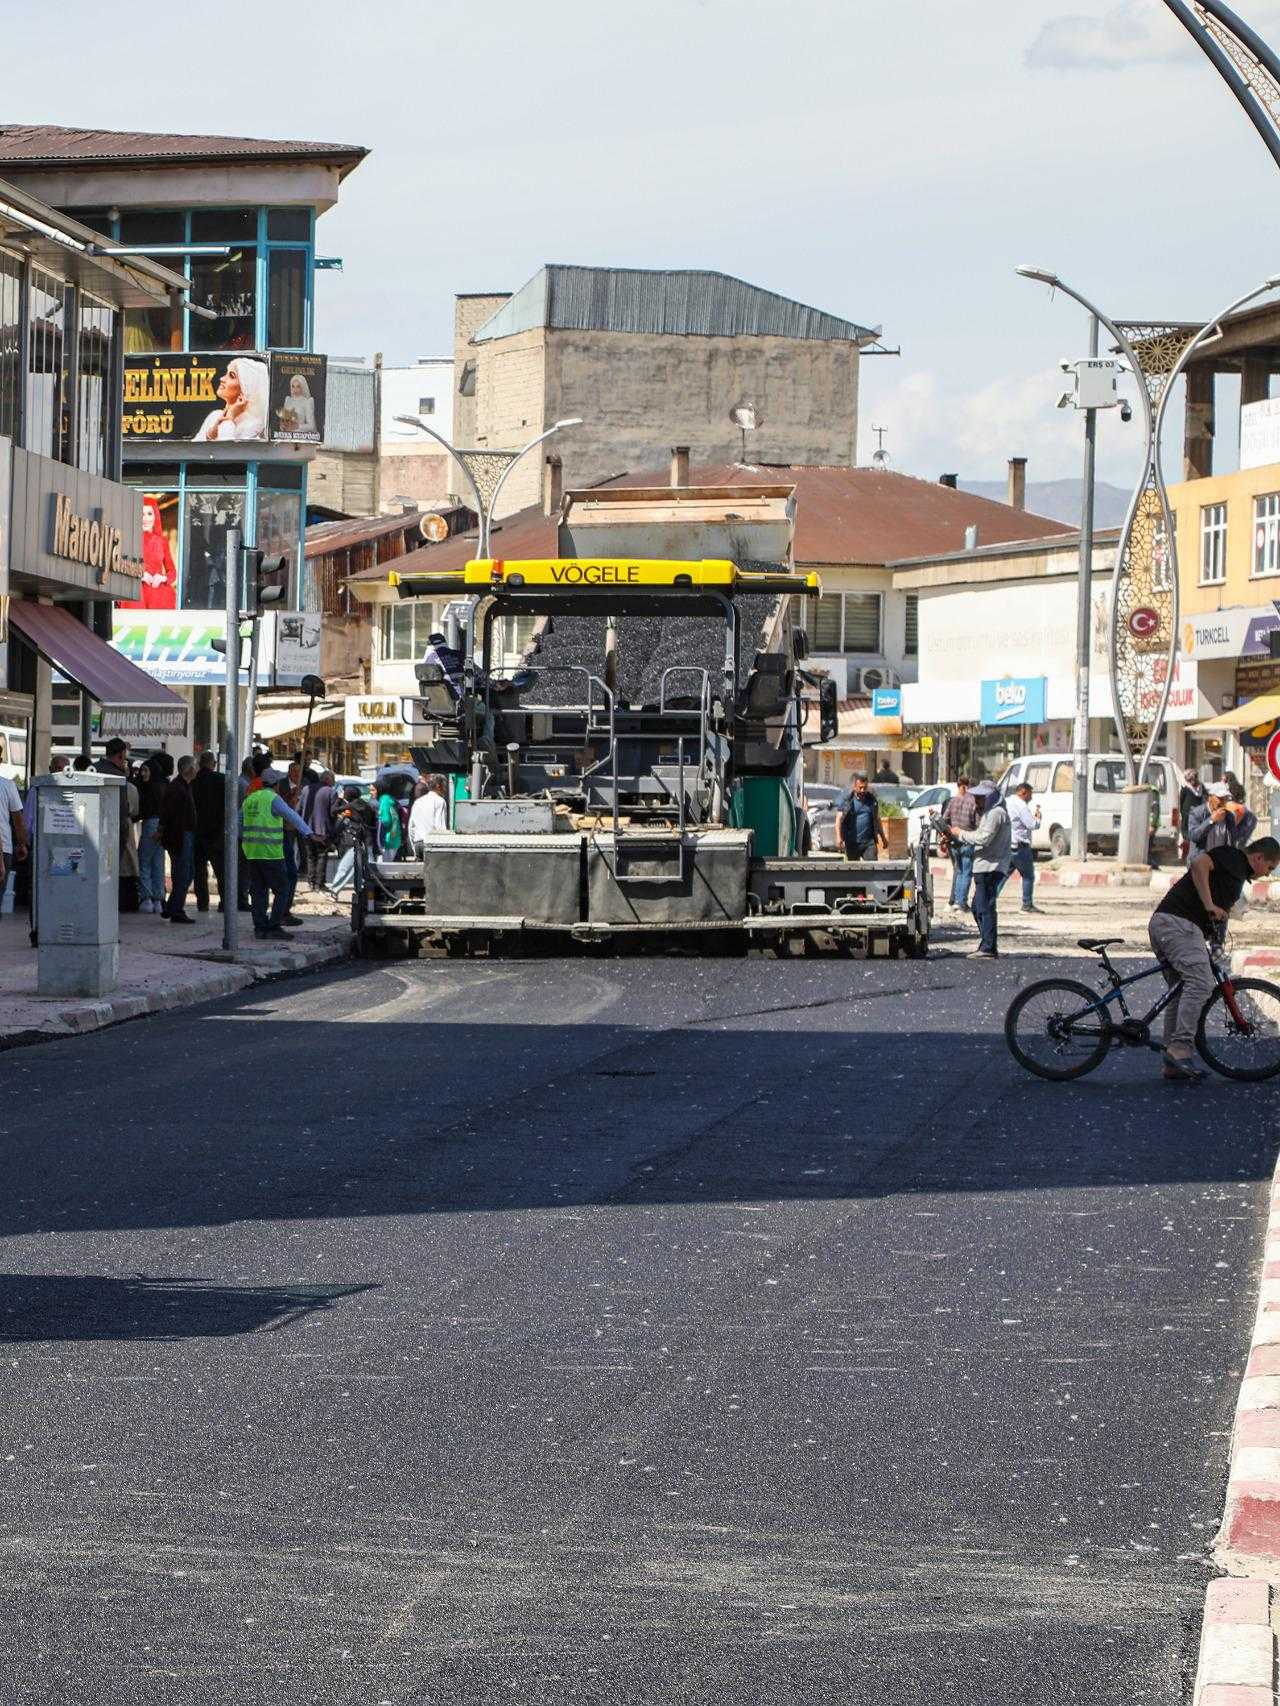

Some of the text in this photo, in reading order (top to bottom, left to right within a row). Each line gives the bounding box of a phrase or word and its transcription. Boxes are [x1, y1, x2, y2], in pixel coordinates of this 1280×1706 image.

[123, 357, 217, 403] ELİNLİK
[122, 408, 174, 434] FÖRÜ
[53, 493, 122, 586] Manolya
[550, 562, 641, 584] VÖGELE
[1195, 627, 1230, 647] TURKCELL
[995, 681, 1026, 706] beko
